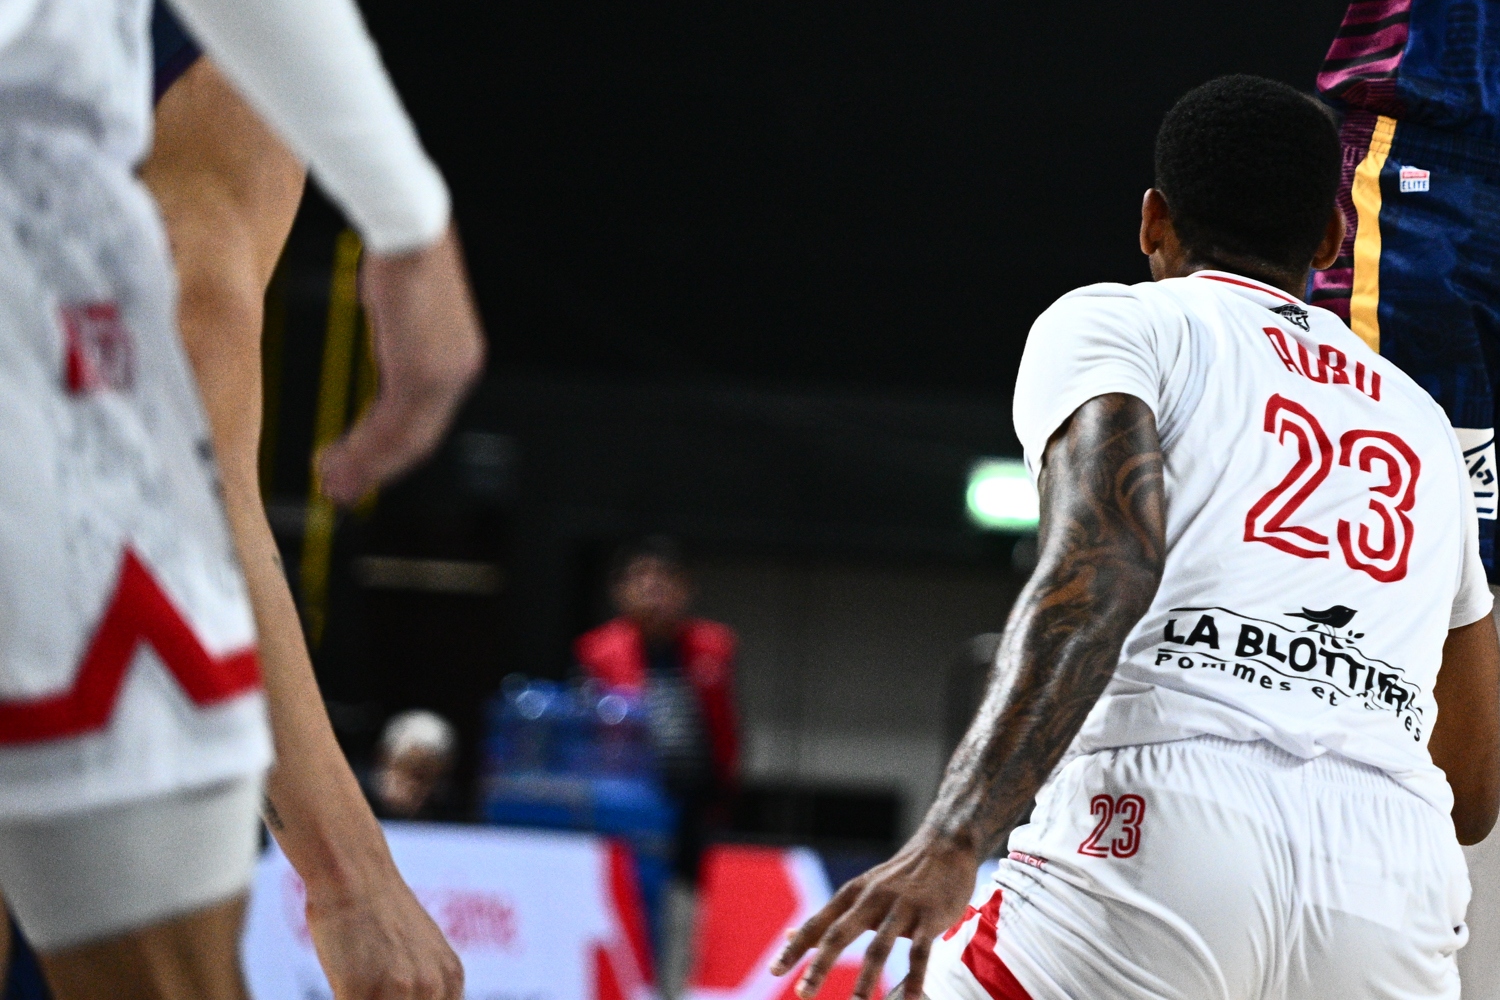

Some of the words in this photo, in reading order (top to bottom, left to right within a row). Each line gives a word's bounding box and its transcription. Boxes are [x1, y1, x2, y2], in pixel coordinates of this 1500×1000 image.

[1243, 392, 1422, 583] 23
[1164, 613, 1220, 650] LA
[1311, 685, 1339, 707] et
[1077, 794, 1145, 858] 23
